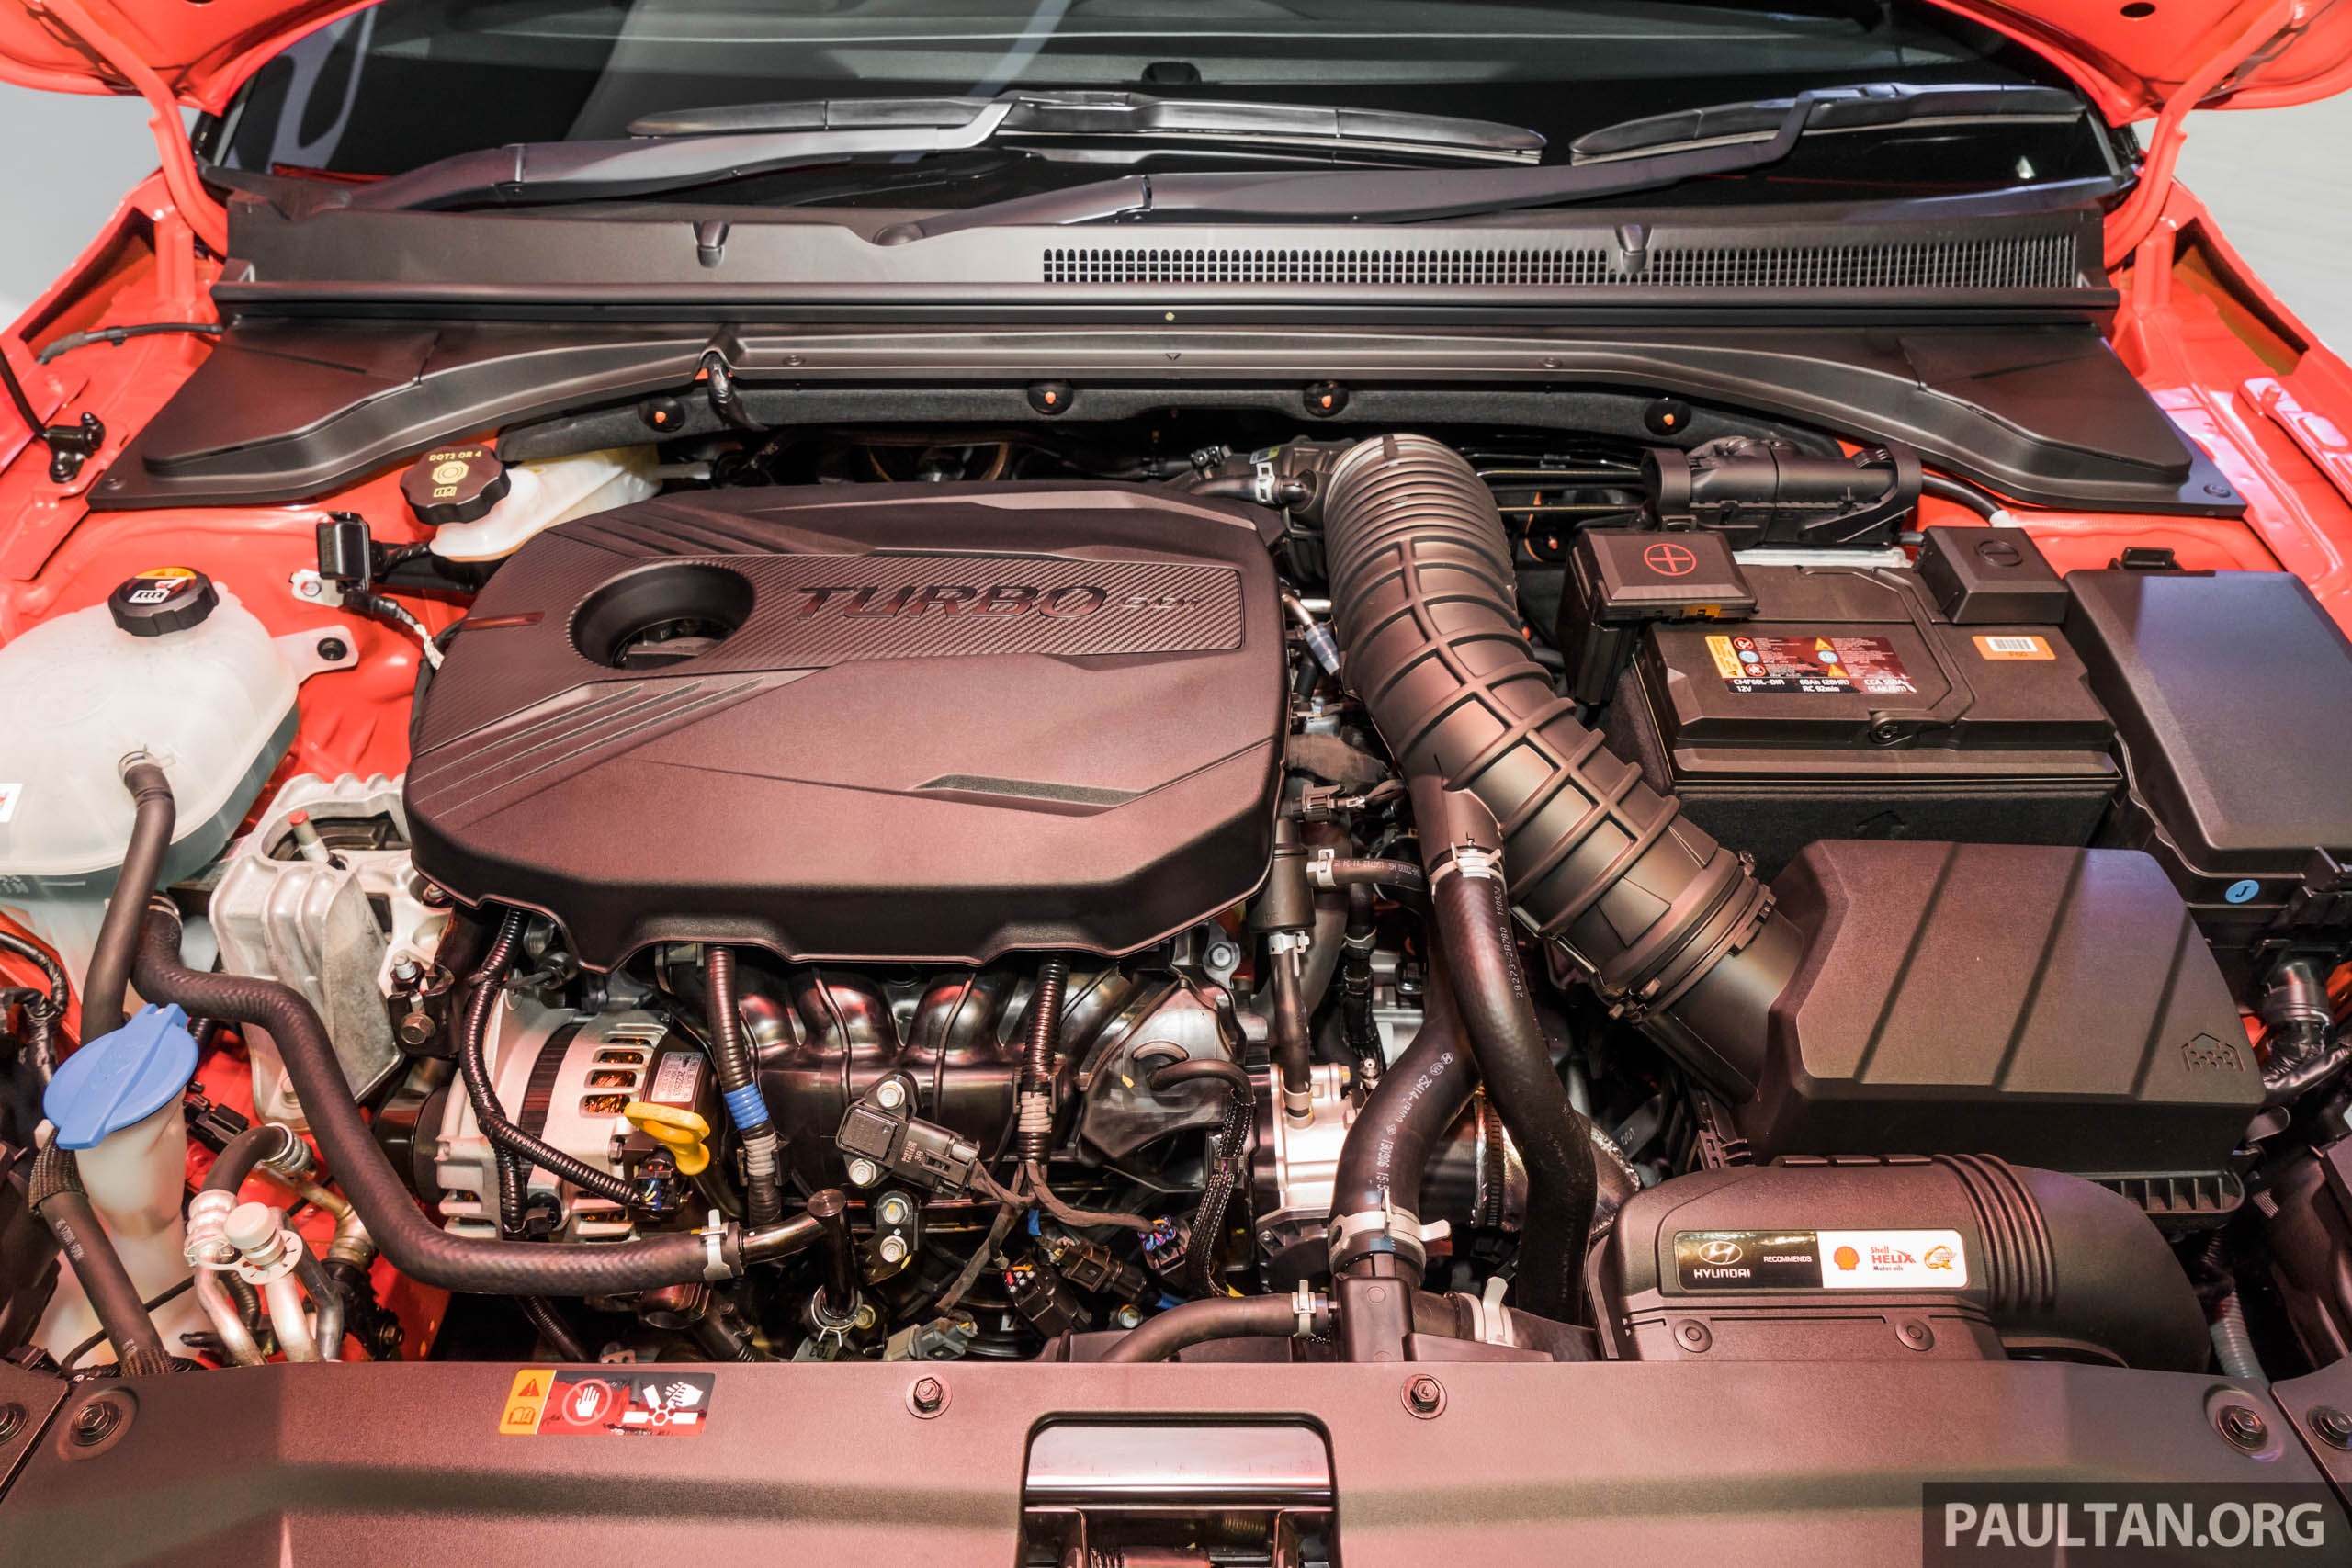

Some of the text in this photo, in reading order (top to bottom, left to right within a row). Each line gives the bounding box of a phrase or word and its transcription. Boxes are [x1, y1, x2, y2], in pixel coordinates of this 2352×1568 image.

[429, 453, 456, 461] DOT3
[458, 451, 473, 459] OR
[797, 584, 1107, 620] TURBO
[2234, 885, 2250, 897] J
[1870, 1246, 1890, 1255] Shell
[1871, 1250, 1917, 1264] HELIX
[1693, 1255, 1813, 1280] HYUNDAI RECOMMENDS
